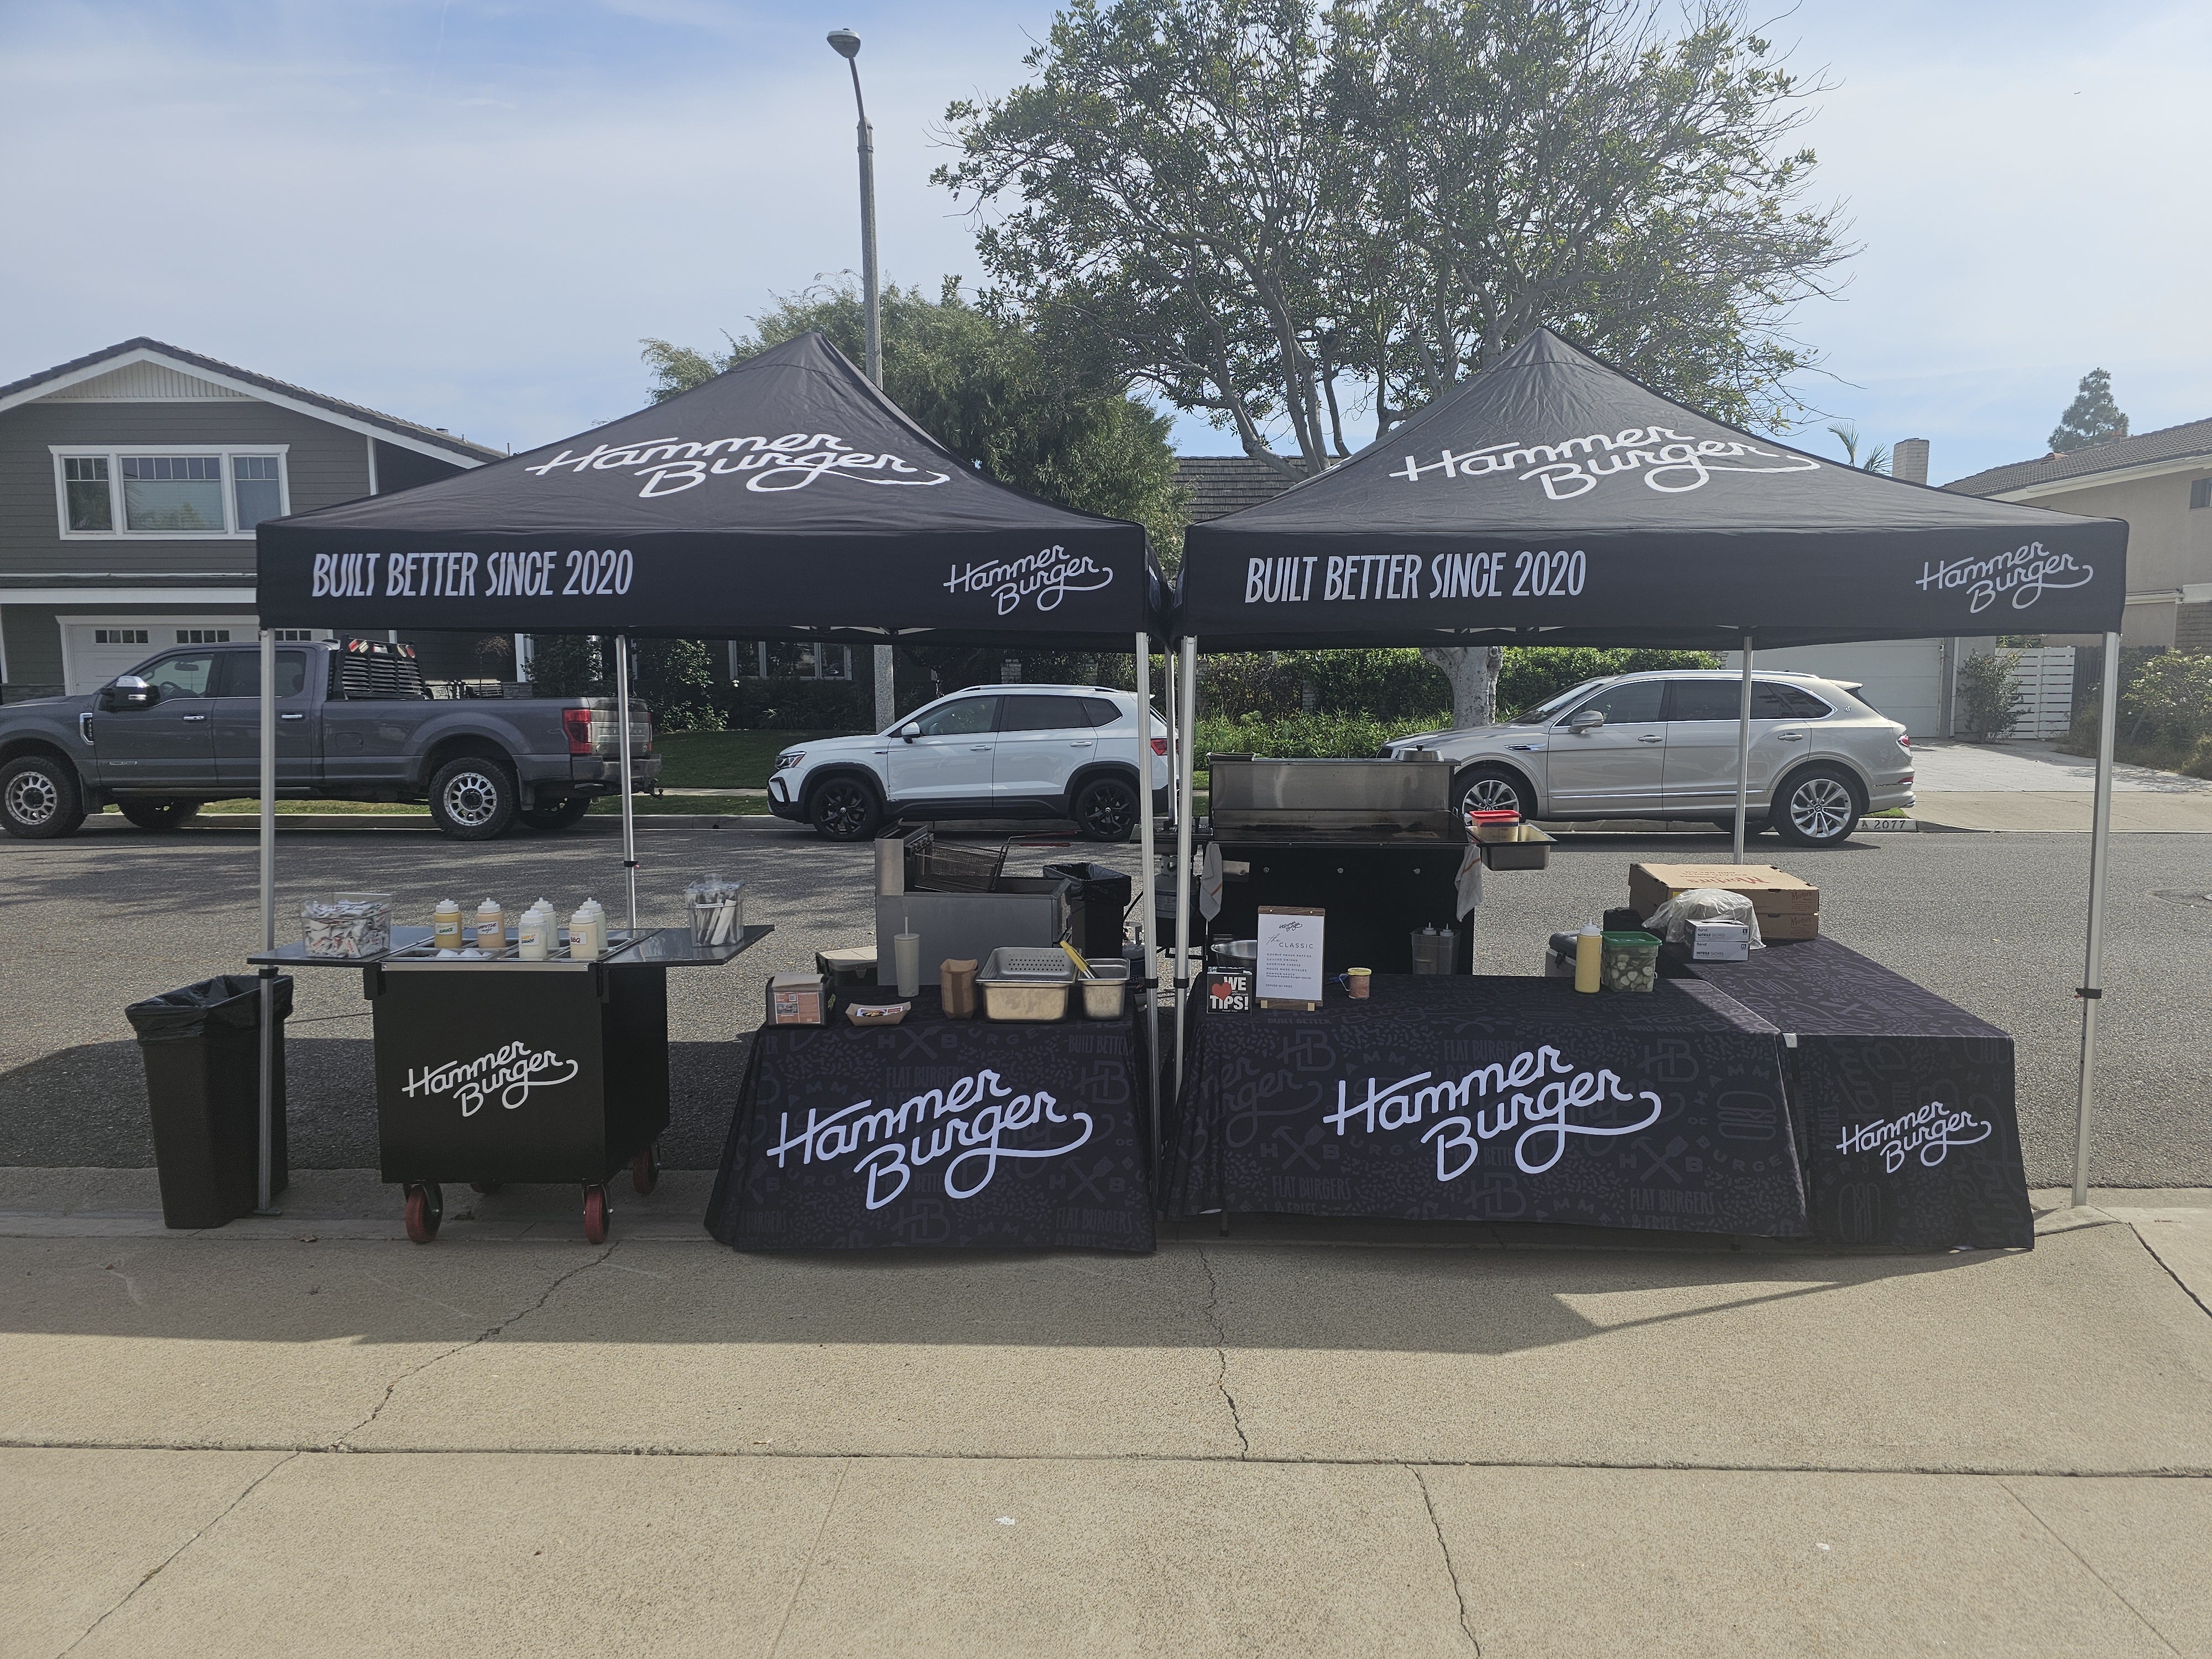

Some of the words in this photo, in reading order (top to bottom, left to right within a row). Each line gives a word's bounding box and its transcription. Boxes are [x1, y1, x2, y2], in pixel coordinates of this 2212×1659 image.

[525, 433, 854, 476] Hammer
[634, 452, 950, 497] Burger
[1389, 426, 1695, 481] Hammer
[1519, 440, 1820, 499] Burger
[312, 554, 380, 597] BUILT
[386, 552, 478, 596] BETTER
[486, 551, 557, 596] SINCE
[562, 550, 633, 594] 2020
[943, 545, 1070, 593] Hammer
[991, 557, 1113, 615] Burger
[1245, 557, 1317, 603] BUILT
[1324, 555, 1422, 600] BETTER
[1430, 552, 1506, 598] SINCE
[1512, 551, 1585, 596] 2020
[1916, 541, 2049, 590] Hammer
[1966, 554, 2093, 613] Burger
[1874, 820, 1906, 830] 2077
[1210, 995, 1249, 1010] TIPS!
[1224, 977, 1246, 990] WE
[402, 1041, 531, 1097] Hammer
[453, 1051, 578, 1117] Burger
[1323, 1045, 1574, 1135] Hammer
[767, 1070, 1012, 1167] Hammer
[1421, 1070, 1661, 1181] Burger
[1836, 1101, 1950, 1155] Hammer
[1880, 1112, 1991, 1173] Burger
[854, 1092, 1092, 1209] Burger
[1630, 1188, 1655, 1211] FLAT
